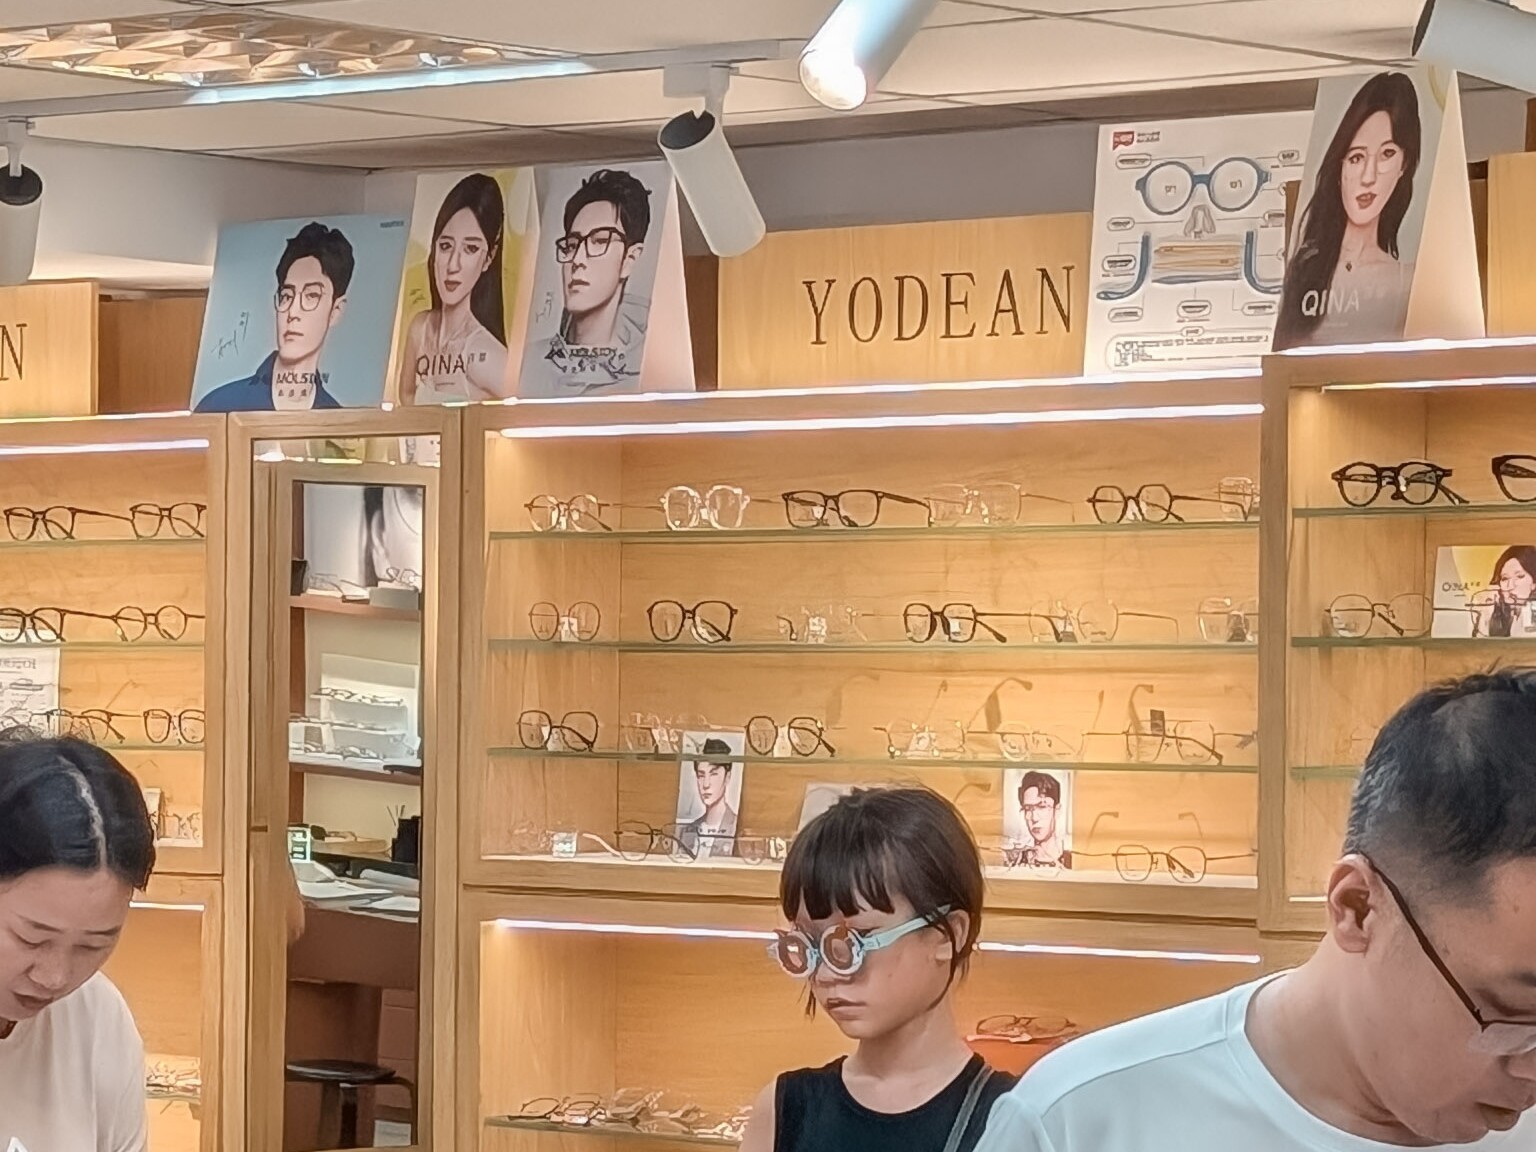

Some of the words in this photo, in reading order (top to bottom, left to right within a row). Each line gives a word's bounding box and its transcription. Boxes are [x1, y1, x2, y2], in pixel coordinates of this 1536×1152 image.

[802, 265, 1076, 345] YODEAN
[1301, 289, 1359, 316] QINA
[416, 353, 465, 376] QINA
